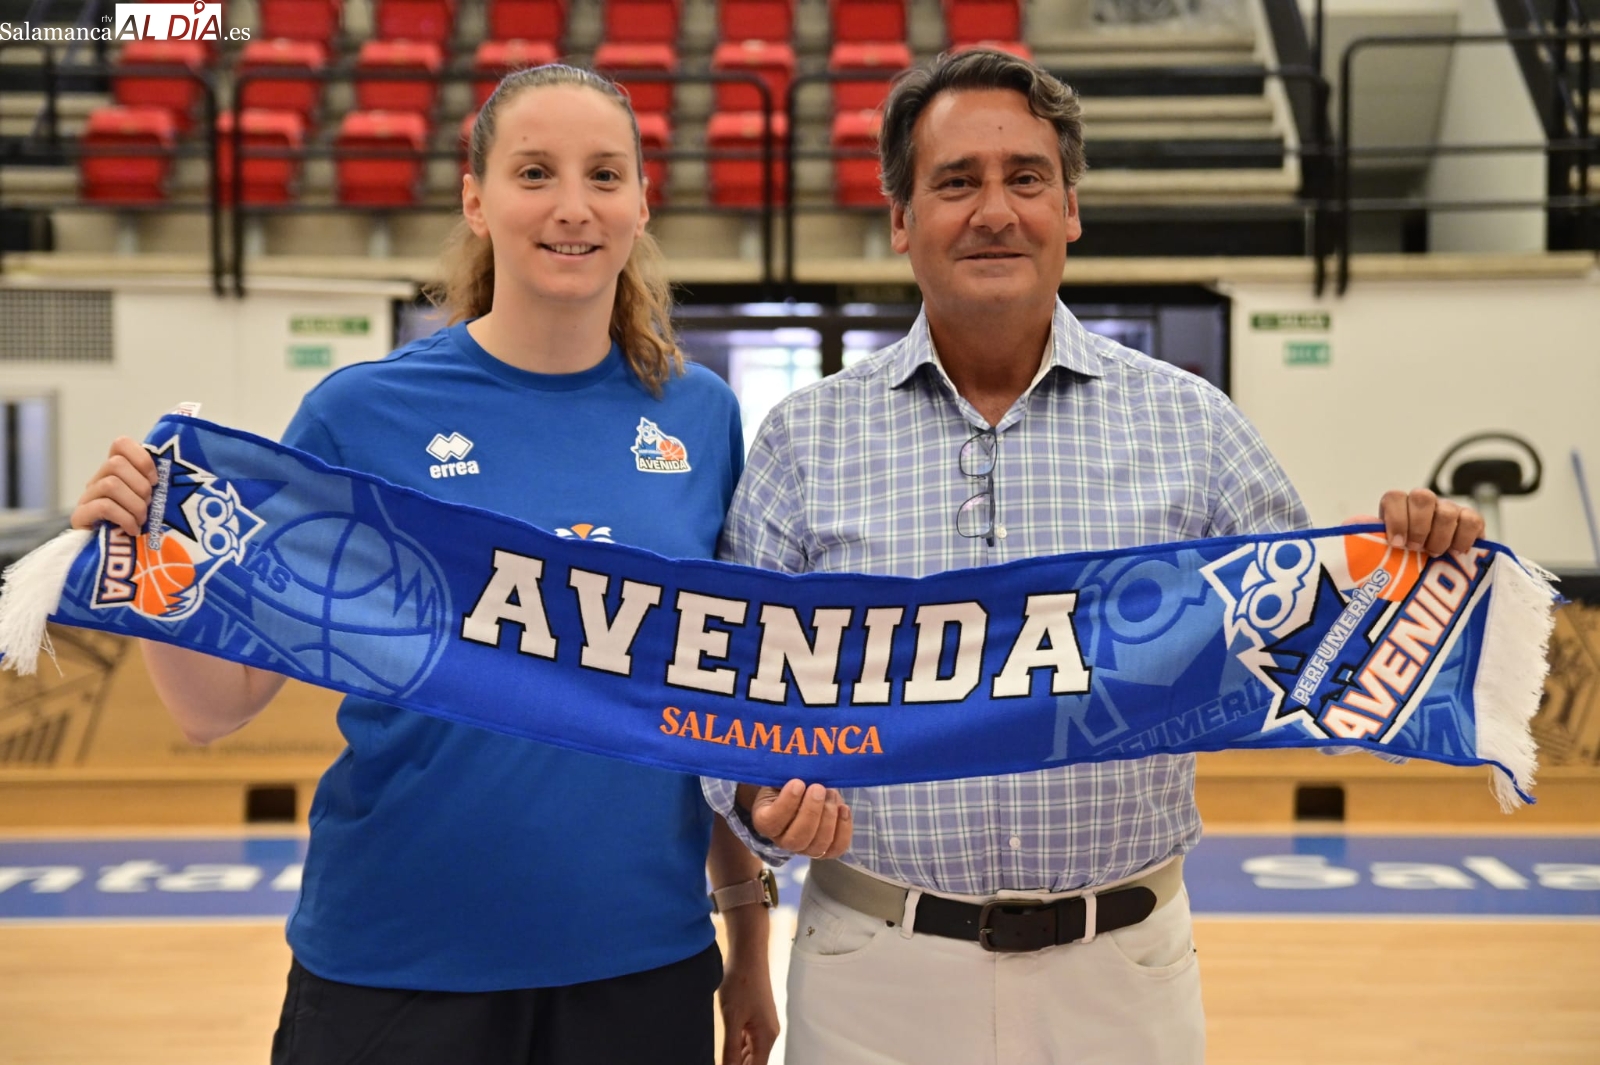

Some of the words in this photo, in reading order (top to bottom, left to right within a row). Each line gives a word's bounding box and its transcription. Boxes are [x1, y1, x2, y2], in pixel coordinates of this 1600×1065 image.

[429, 460, 480, 479] errea
[639, 457, 689, 470] AVENIDA
[101, 528, 133, 601] NIDA
[461, 548, 1093, 708] AVENIDA
[1321, 546, 1491, 740] AVENIDA
[660, 706, 884, 757] SALAMANCA
